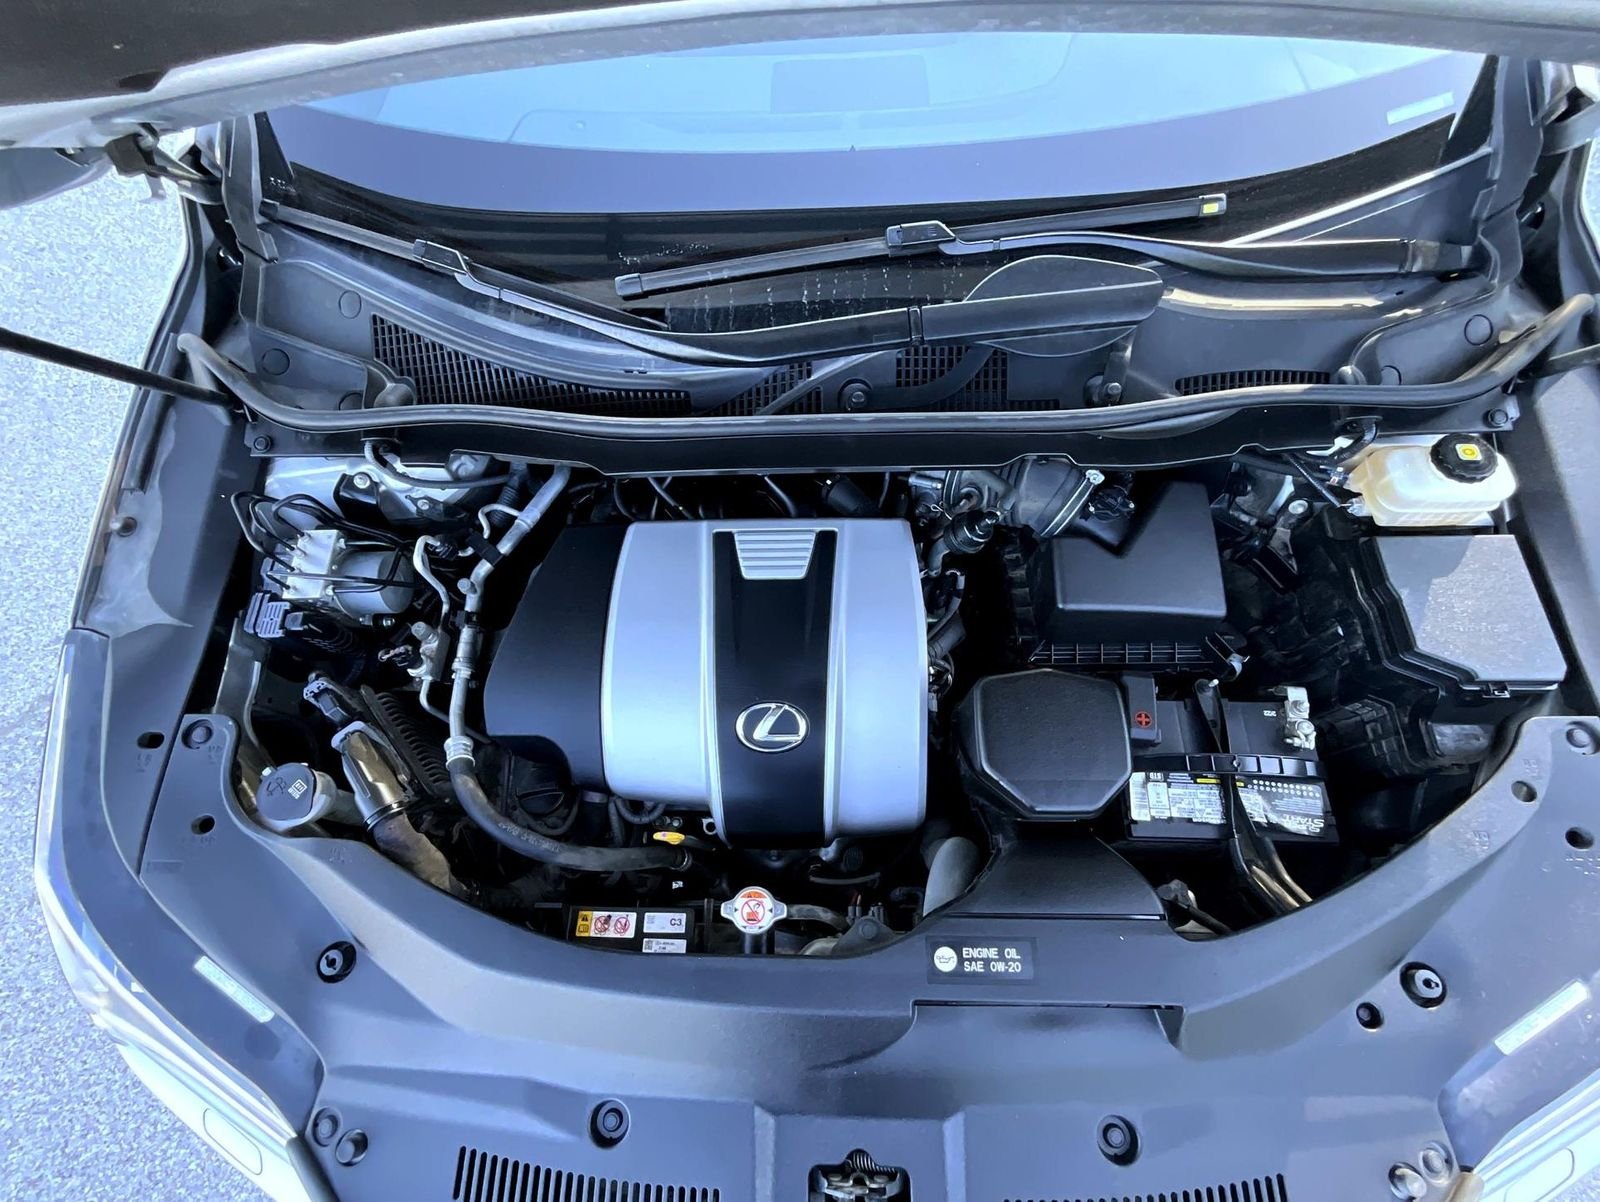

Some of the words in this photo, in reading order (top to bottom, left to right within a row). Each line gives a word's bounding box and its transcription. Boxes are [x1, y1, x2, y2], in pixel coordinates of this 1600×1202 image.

[669, 917, 682, 927] C3
[962, 947, 999, 959] ENGINE
[1004, 947, 1021, 959] OIL
[963, 961, 985, 972] SAE
[989, 961, 1022, 973] 0W-20
